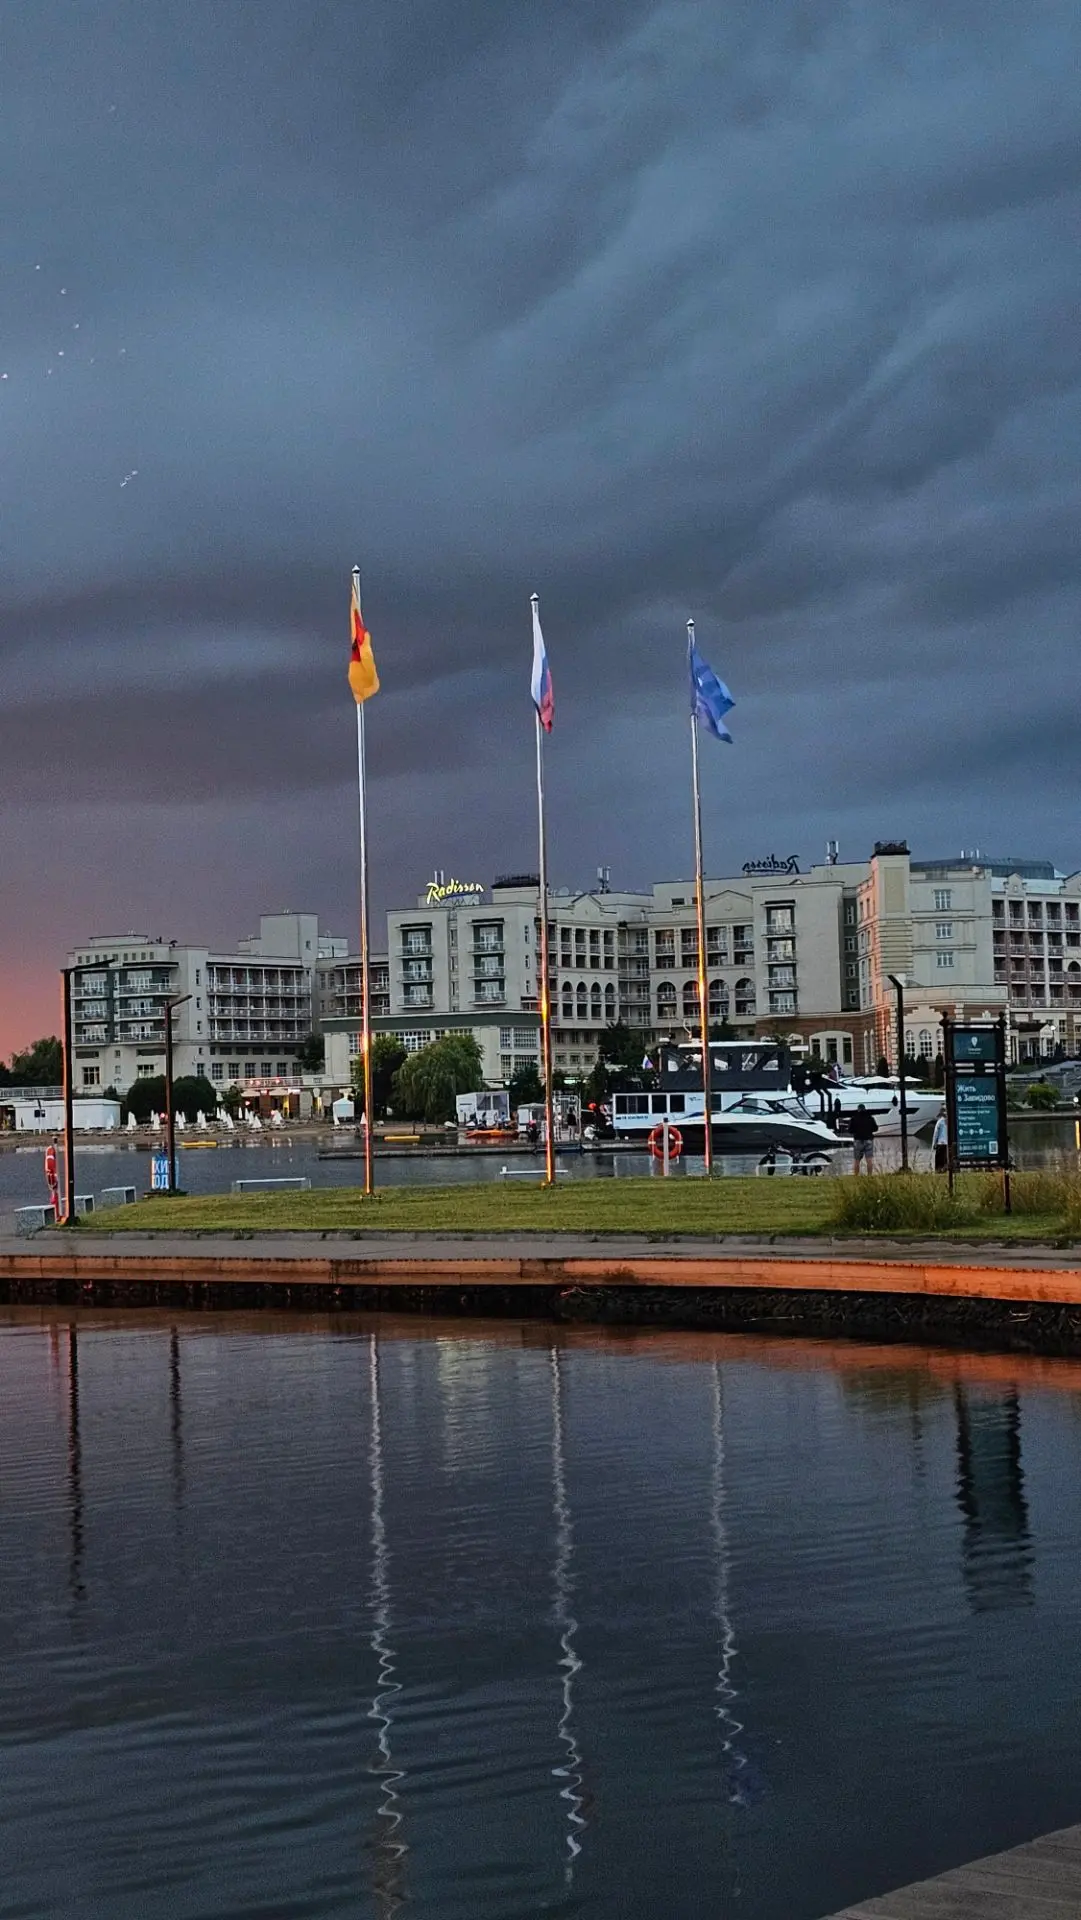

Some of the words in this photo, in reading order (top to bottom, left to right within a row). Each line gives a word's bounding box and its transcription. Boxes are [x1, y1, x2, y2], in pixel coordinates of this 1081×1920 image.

[426, 878, 484, 905] Radisson
[957, 1084, 976, 1093] Жить
[964, 1093, 996, 1102] Завидово
